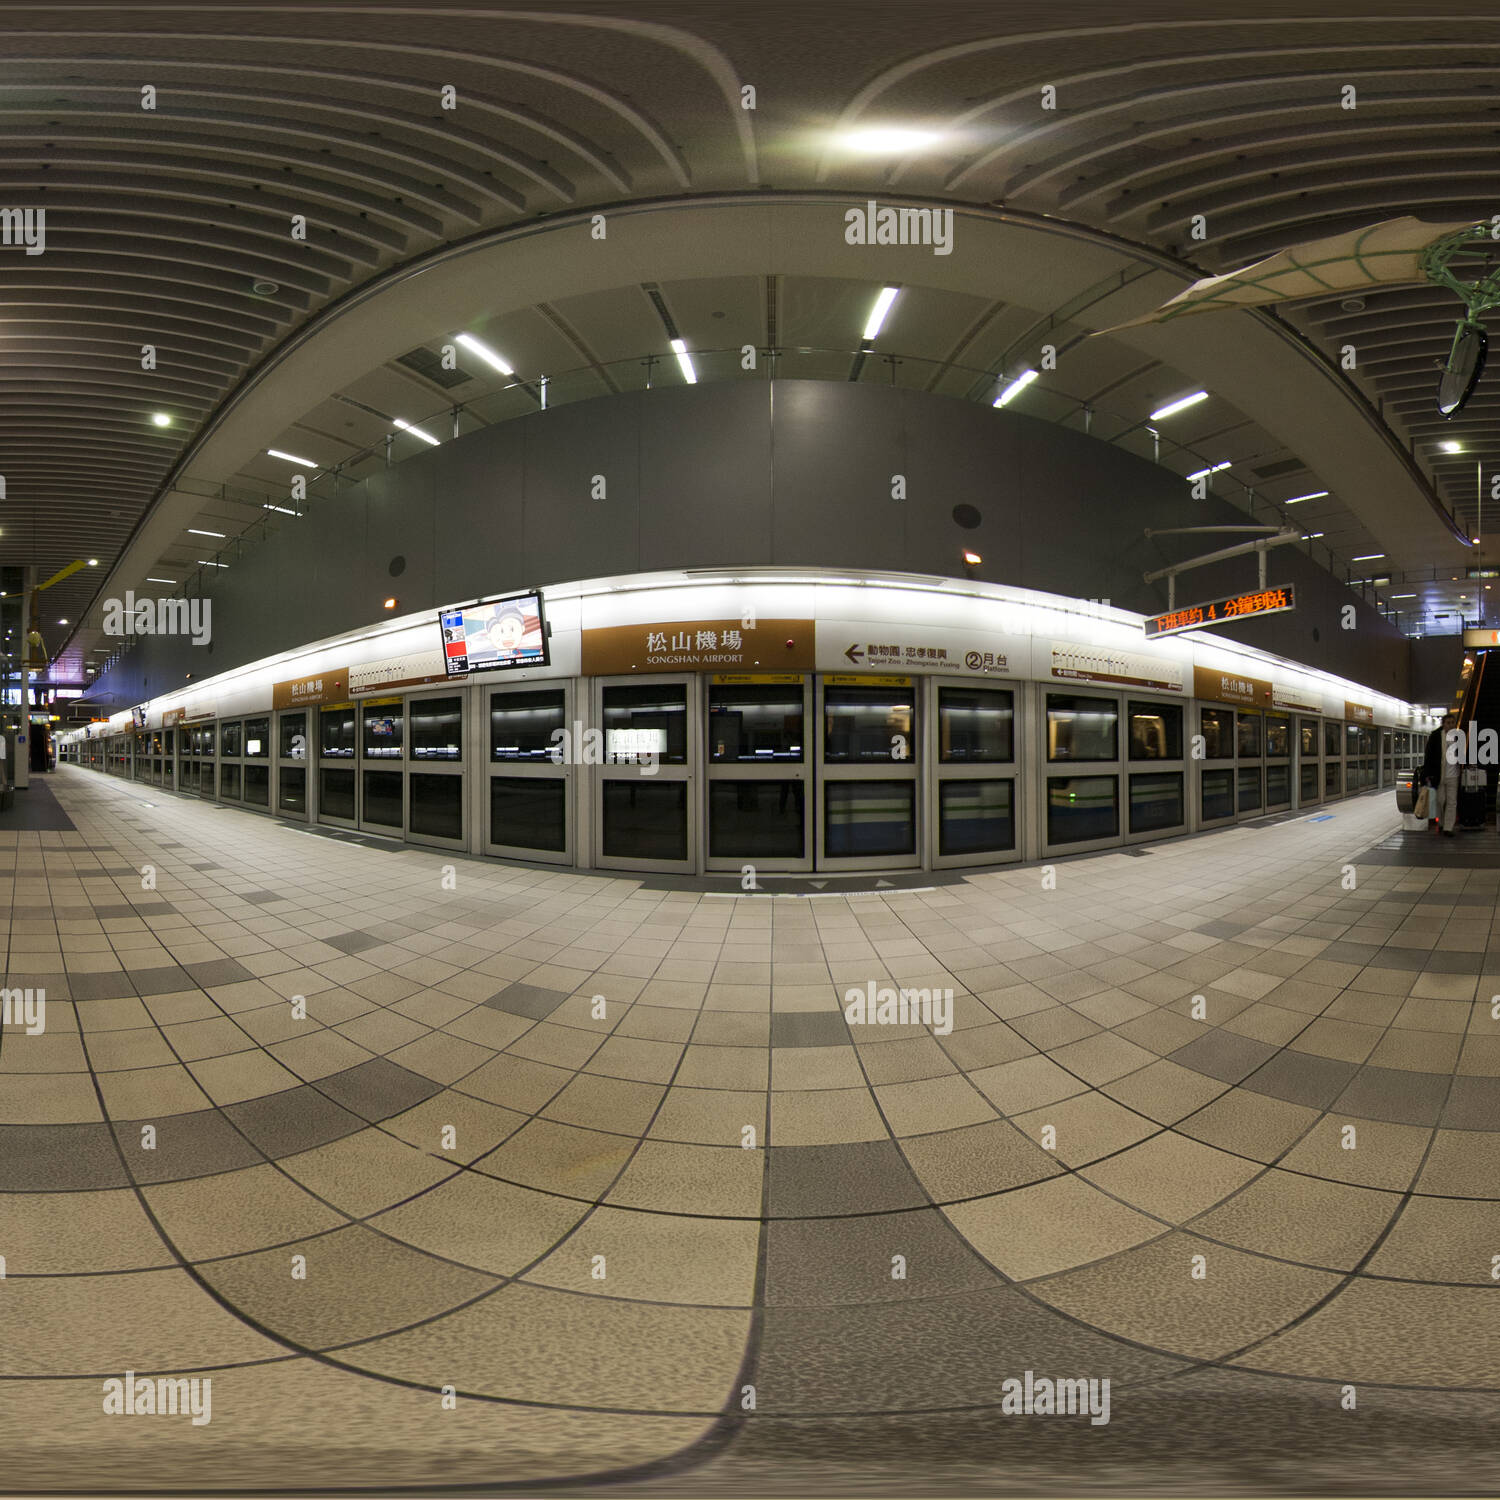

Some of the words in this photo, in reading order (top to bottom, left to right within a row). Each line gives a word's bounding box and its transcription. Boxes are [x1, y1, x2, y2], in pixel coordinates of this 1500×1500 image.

[1155, 608, 1203, 632] 下班車約
[1208, 605, 1217, 620] 4
[1224, 589, 1287, 617] 分鐘到站
[646, 630, 743, 652] 松山機場
[647, 655, 700, 664] SONGSHAN
[702, 654, 743, 663] AIRPORT
[292, 679, 323, 697] 松山機場
[1221, 677, 1254, 697] 松山機場
